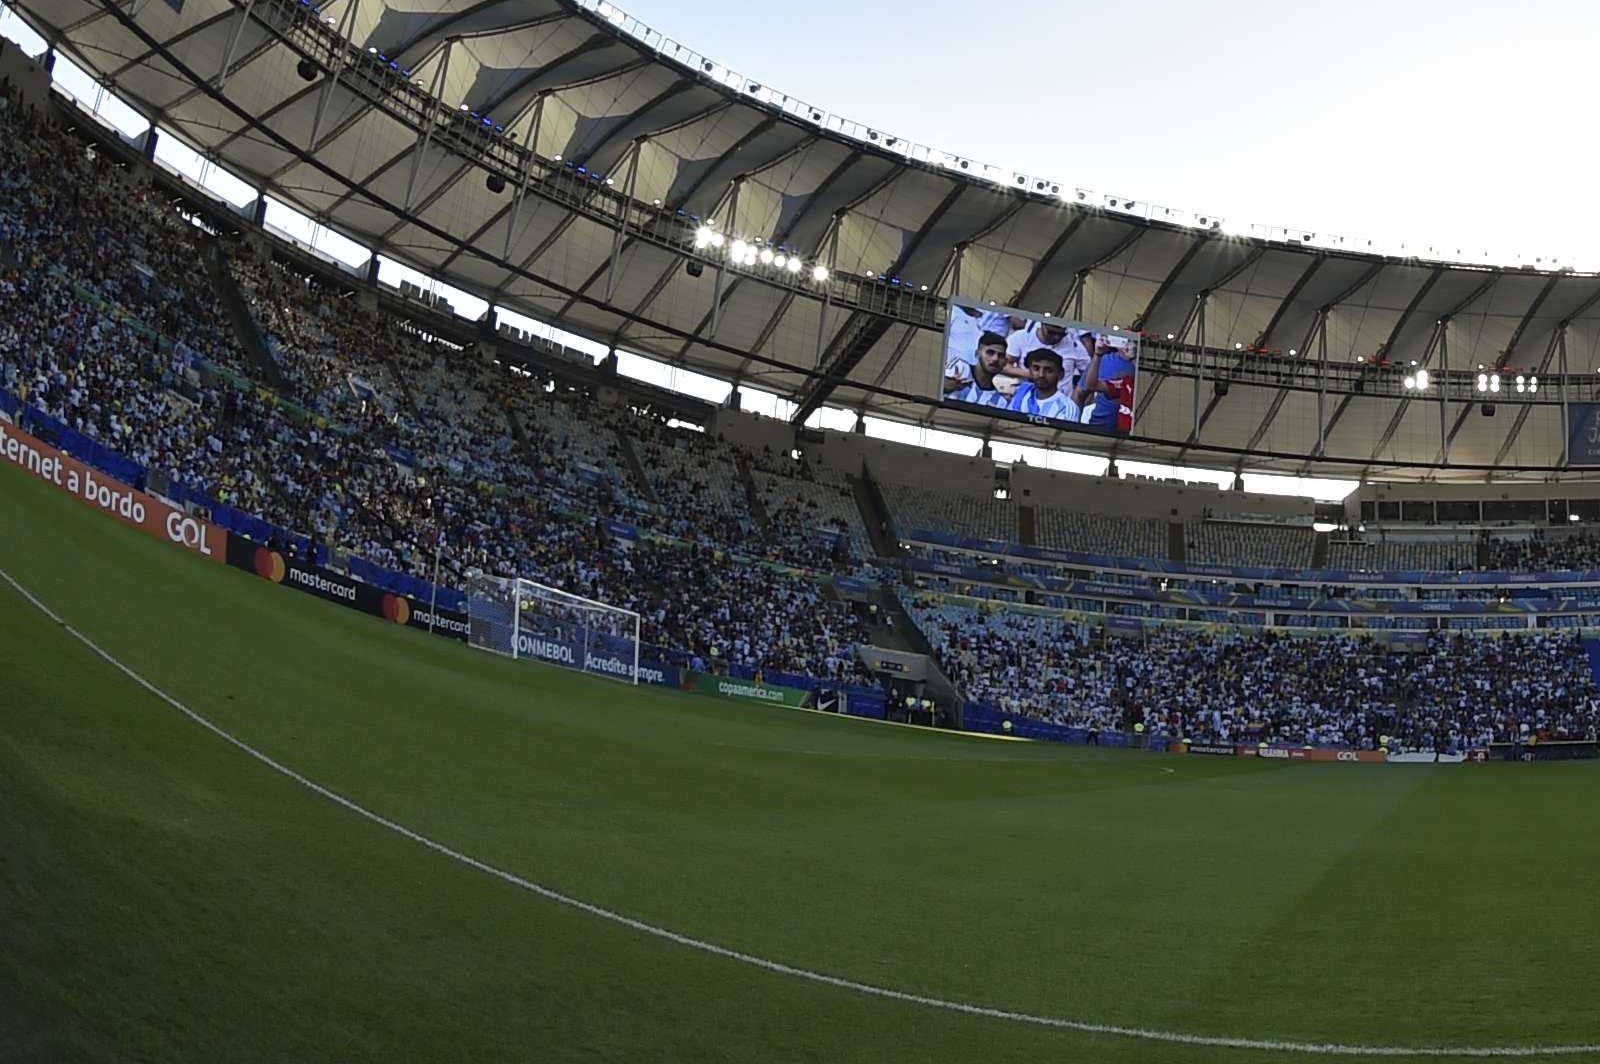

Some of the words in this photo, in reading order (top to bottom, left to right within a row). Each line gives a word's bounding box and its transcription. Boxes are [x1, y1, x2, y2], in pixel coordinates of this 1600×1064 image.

[1028, 414, 1050, 425] TCL
[0, 425, 63, 486] ternet
[68, 470, 79, 494] a
[84, 471, 145, 524] bordo
[166, 511, 211, 556] GOL
[289, 566, 356, 601] mastercard
[1104, 586, 1134, 596] AMERICA
[414, 609, 472, 635] mastercard
[511, 633, 575, 664] CONMEBOL
[585, 651, 627, 676] Acredite
[628, 664, 666, 685] smpre.
[719, 680, 784, 702] copaamerica.com
[1189, 745, 1234, 754] mastercard
[1337, 751, 1359, 762] GOL
